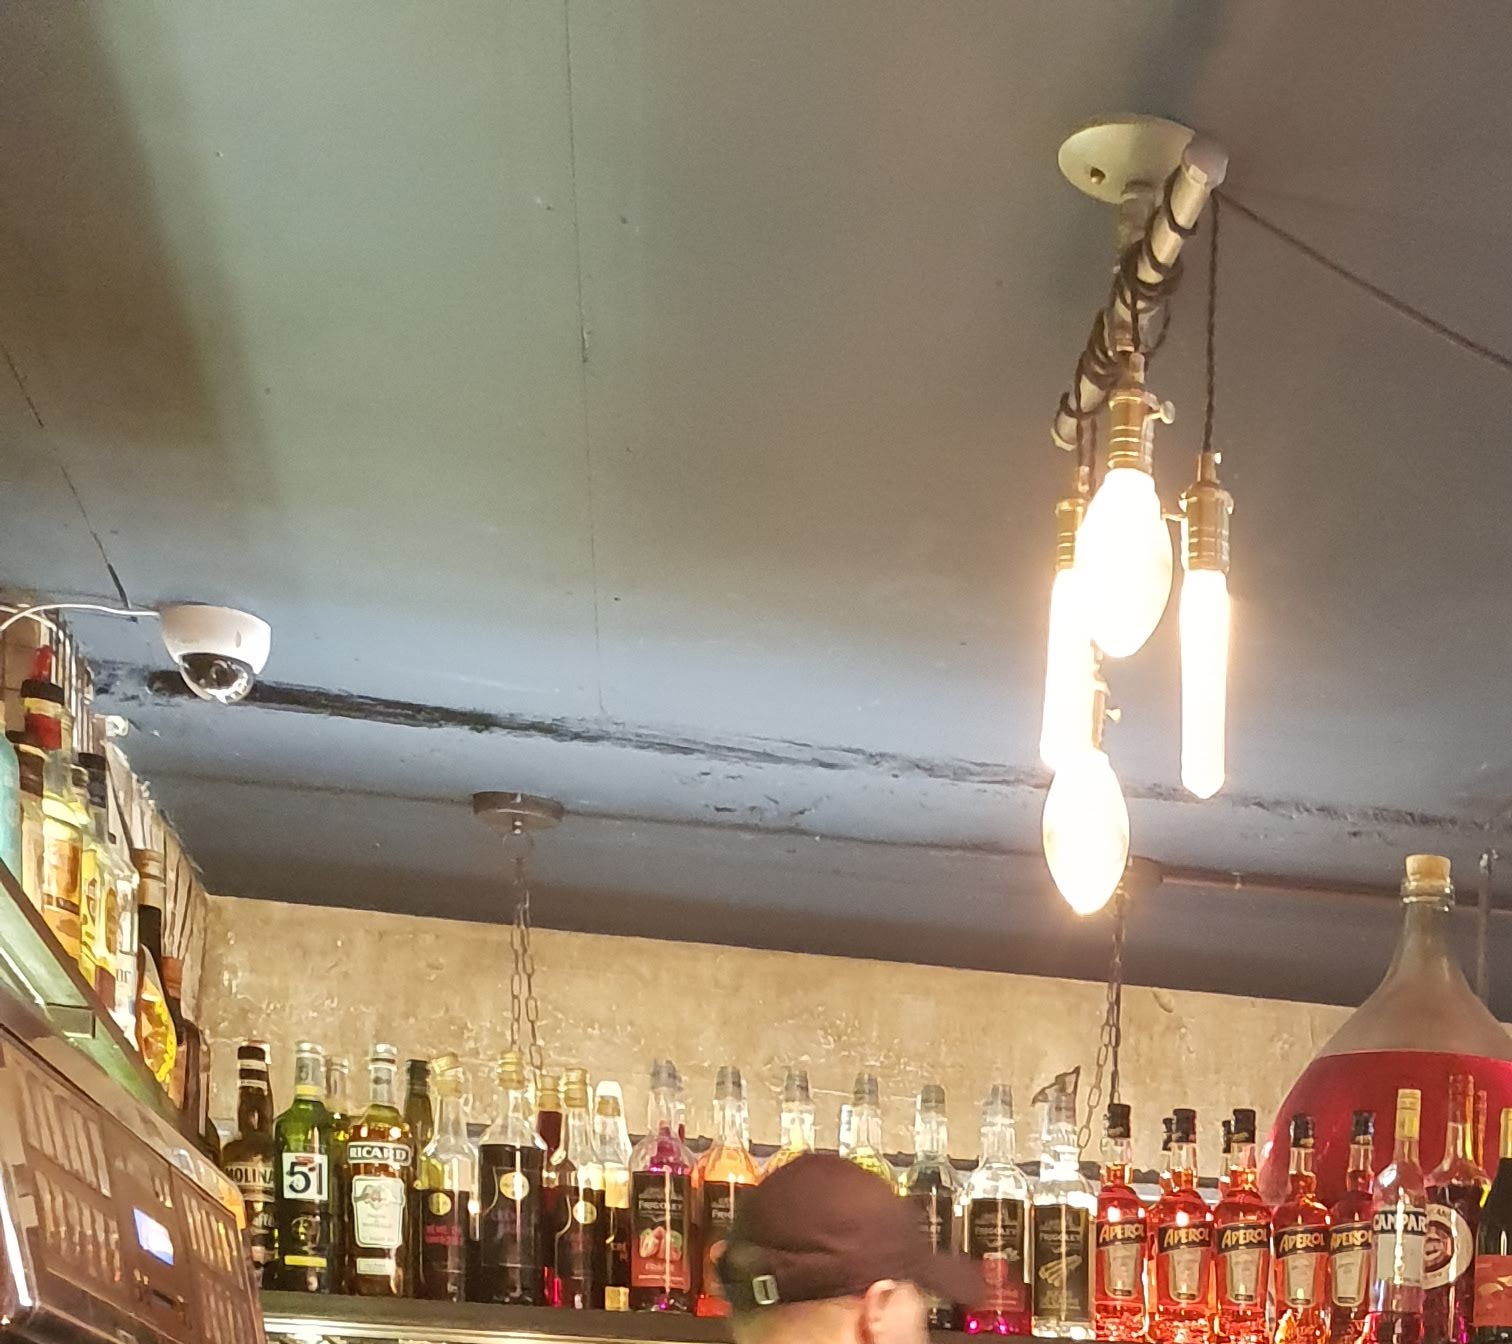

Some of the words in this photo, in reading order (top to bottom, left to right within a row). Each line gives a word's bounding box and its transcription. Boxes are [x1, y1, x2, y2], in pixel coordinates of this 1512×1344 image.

[350, 1146, 407, 1161] RICARD
[287, 1161, 322, 1195] 51
[1100, 1223, 1145, 1243] APEROL
[1164, 1227, 1209, 1248] APEROL
[1221, 1228, 1268, 1249] APEROL
[1280, 1232, 1325, 1253] APEROL
